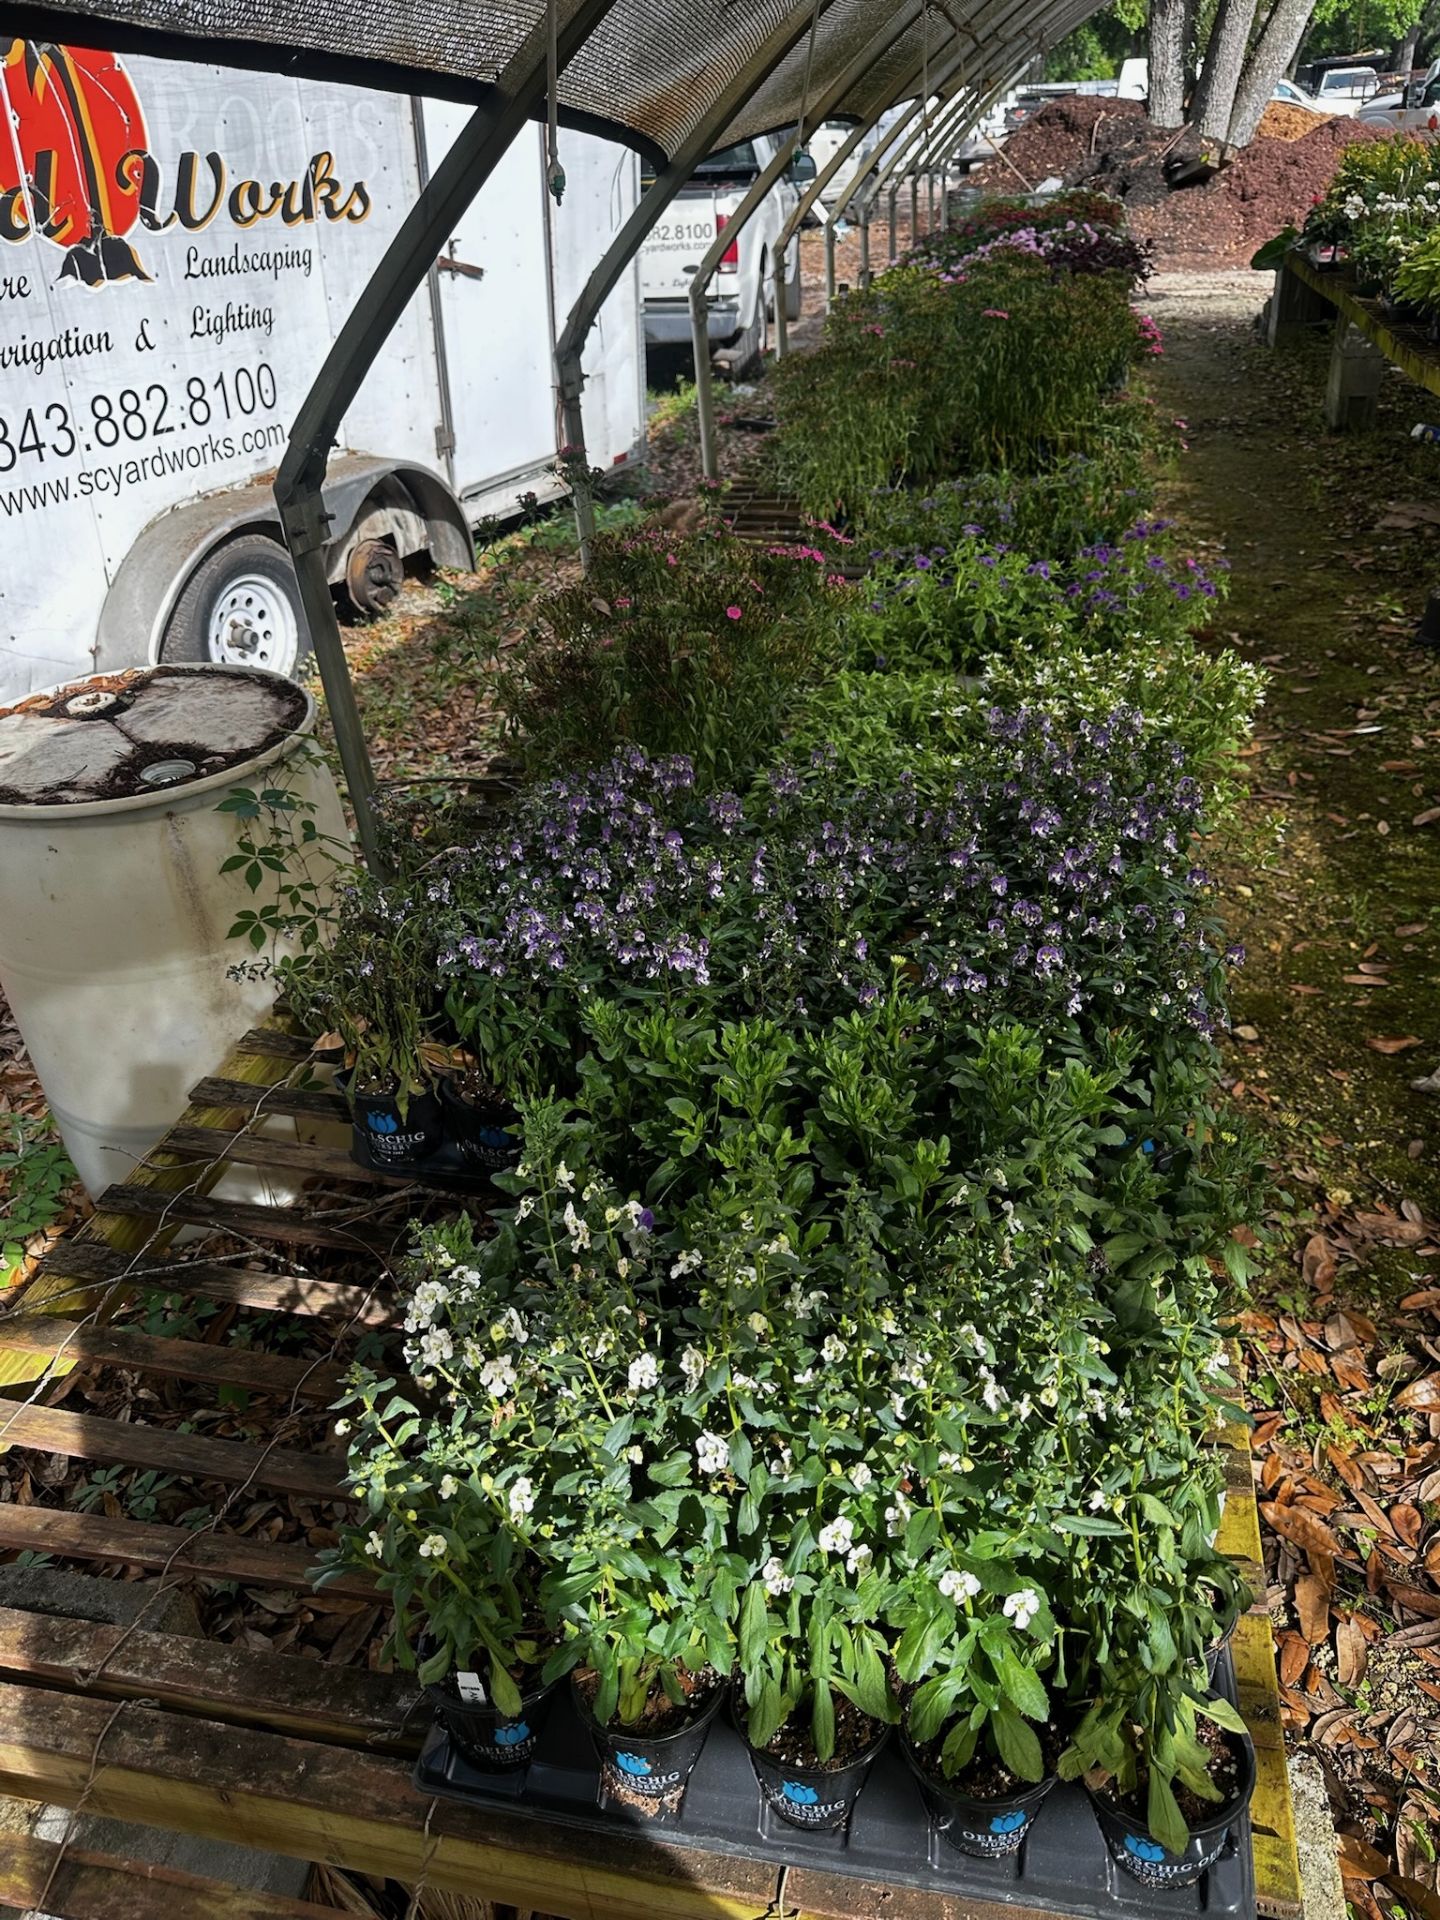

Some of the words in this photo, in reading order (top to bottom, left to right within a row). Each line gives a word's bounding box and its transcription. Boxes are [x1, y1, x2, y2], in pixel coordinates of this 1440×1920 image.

[115, 150, 372, 233] Works
[0, 275, 32, 300] re
[184, 243, 313, 281] Landscaping
[135, 318, 156, 352] &
[190, 302, 275, 345] Lighting
